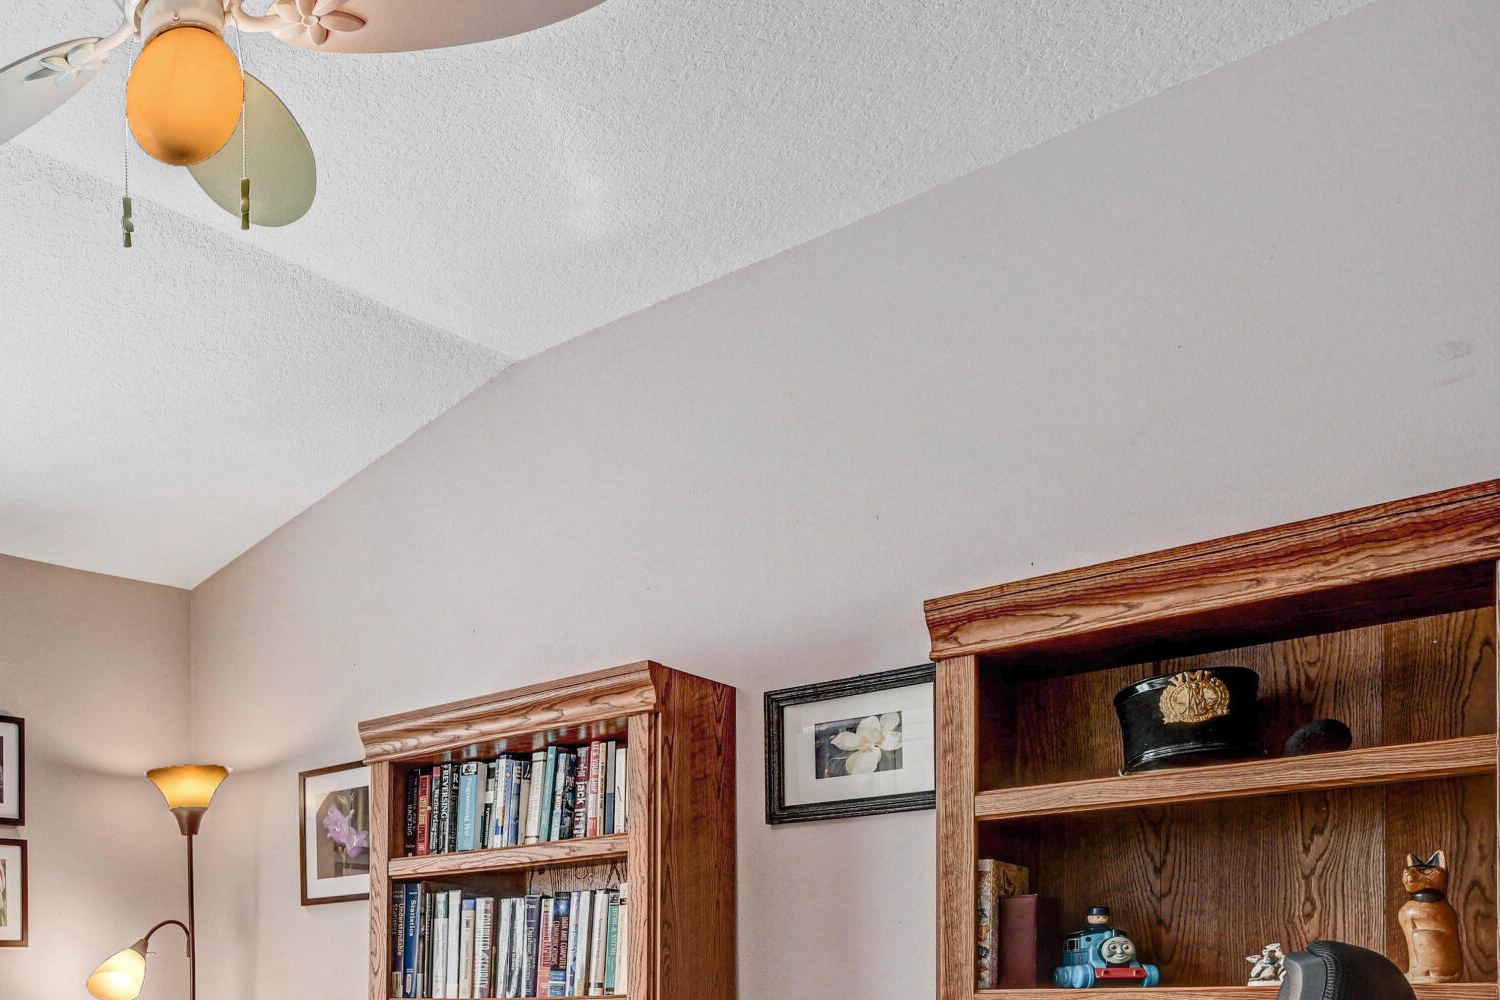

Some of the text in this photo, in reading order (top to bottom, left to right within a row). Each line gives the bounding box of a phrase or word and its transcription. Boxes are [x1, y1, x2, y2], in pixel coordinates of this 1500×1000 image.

[432, 789, 440, 832] WarDriving
[441, 770, 449, 819] REVERSING
[463, 778, 473, 822] Programming
[409, 900, 417, 937] Statistics
[561, 917, 569, 929] DATA
[526, 927, 535, 954] Database
[550, 920, 560, 966] COMMUNICATIONS
[560, 930, 568, 941] AND
[525, 956, 533, 981] Systems
[558, 942, 568, 970] COMPUTER
